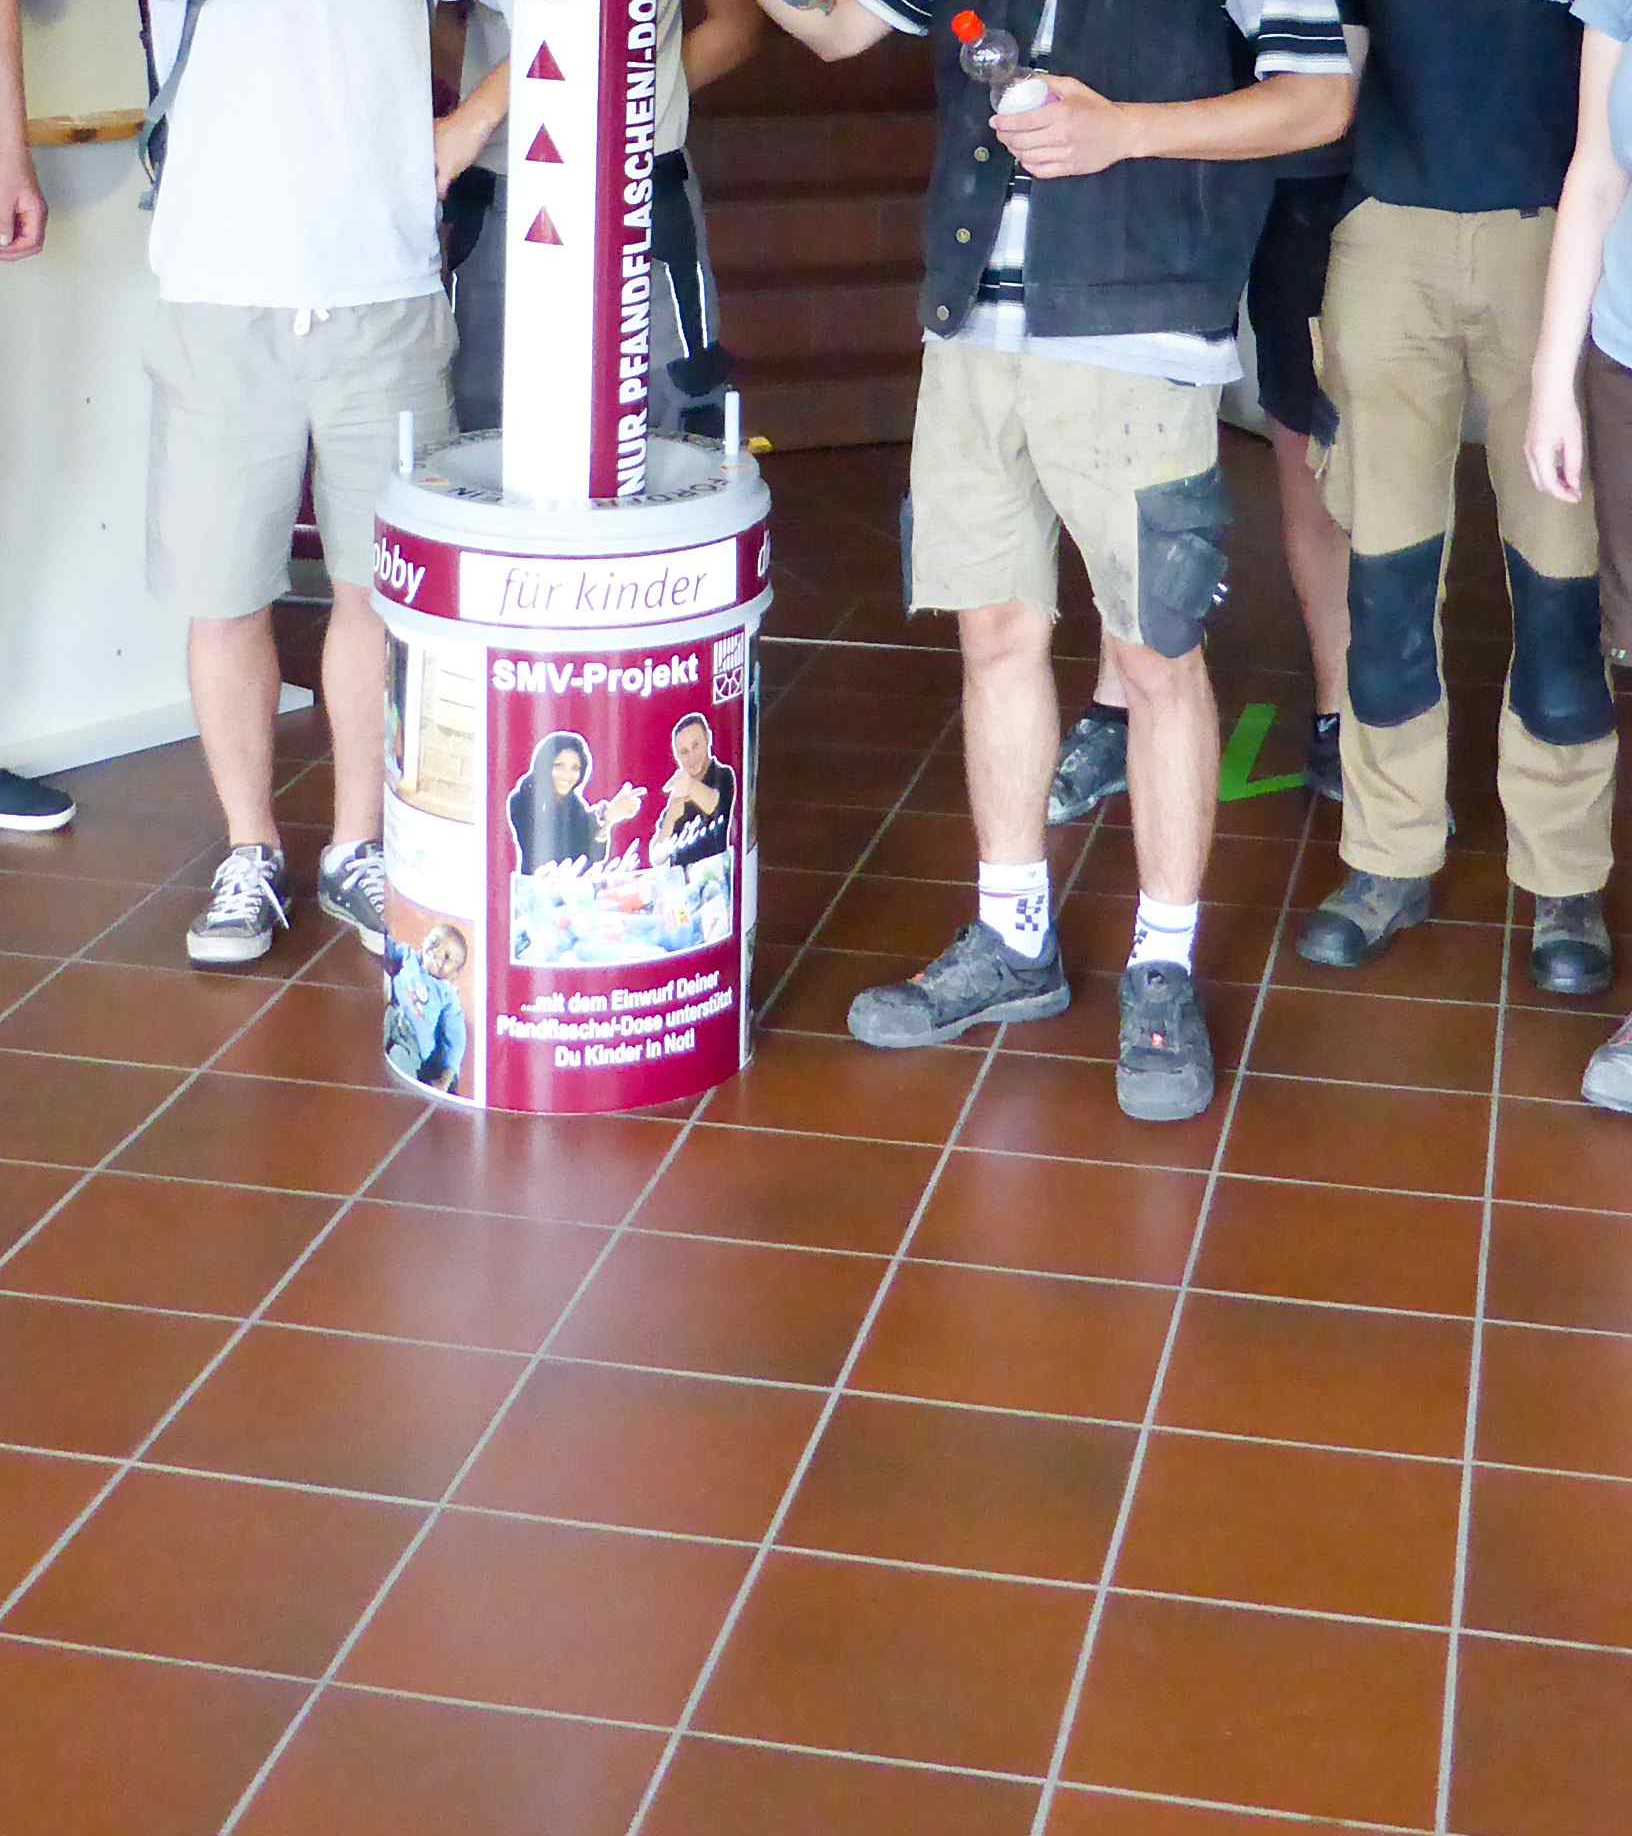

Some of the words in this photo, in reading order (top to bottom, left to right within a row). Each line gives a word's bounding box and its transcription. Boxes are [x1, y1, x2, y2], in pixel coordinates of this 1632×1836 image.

[616, 407, 648, 497] NUR
[500, 567, 564, 616] für
[576, 567, 708, 612] kinder
[492, 652, 700, 698] SMV-Projekt
[568, 991, 608, 1012] dem
[611, 979, 675, 1011] Einwurf
[676, 970, 720, 997] Deiner
[554, 1045, 581, 1067] Du
[584, 1042, 643, 1067] Kinder
[646, 1038, 662, 1059] in
[664, 1028, 696, 1055] Not!
